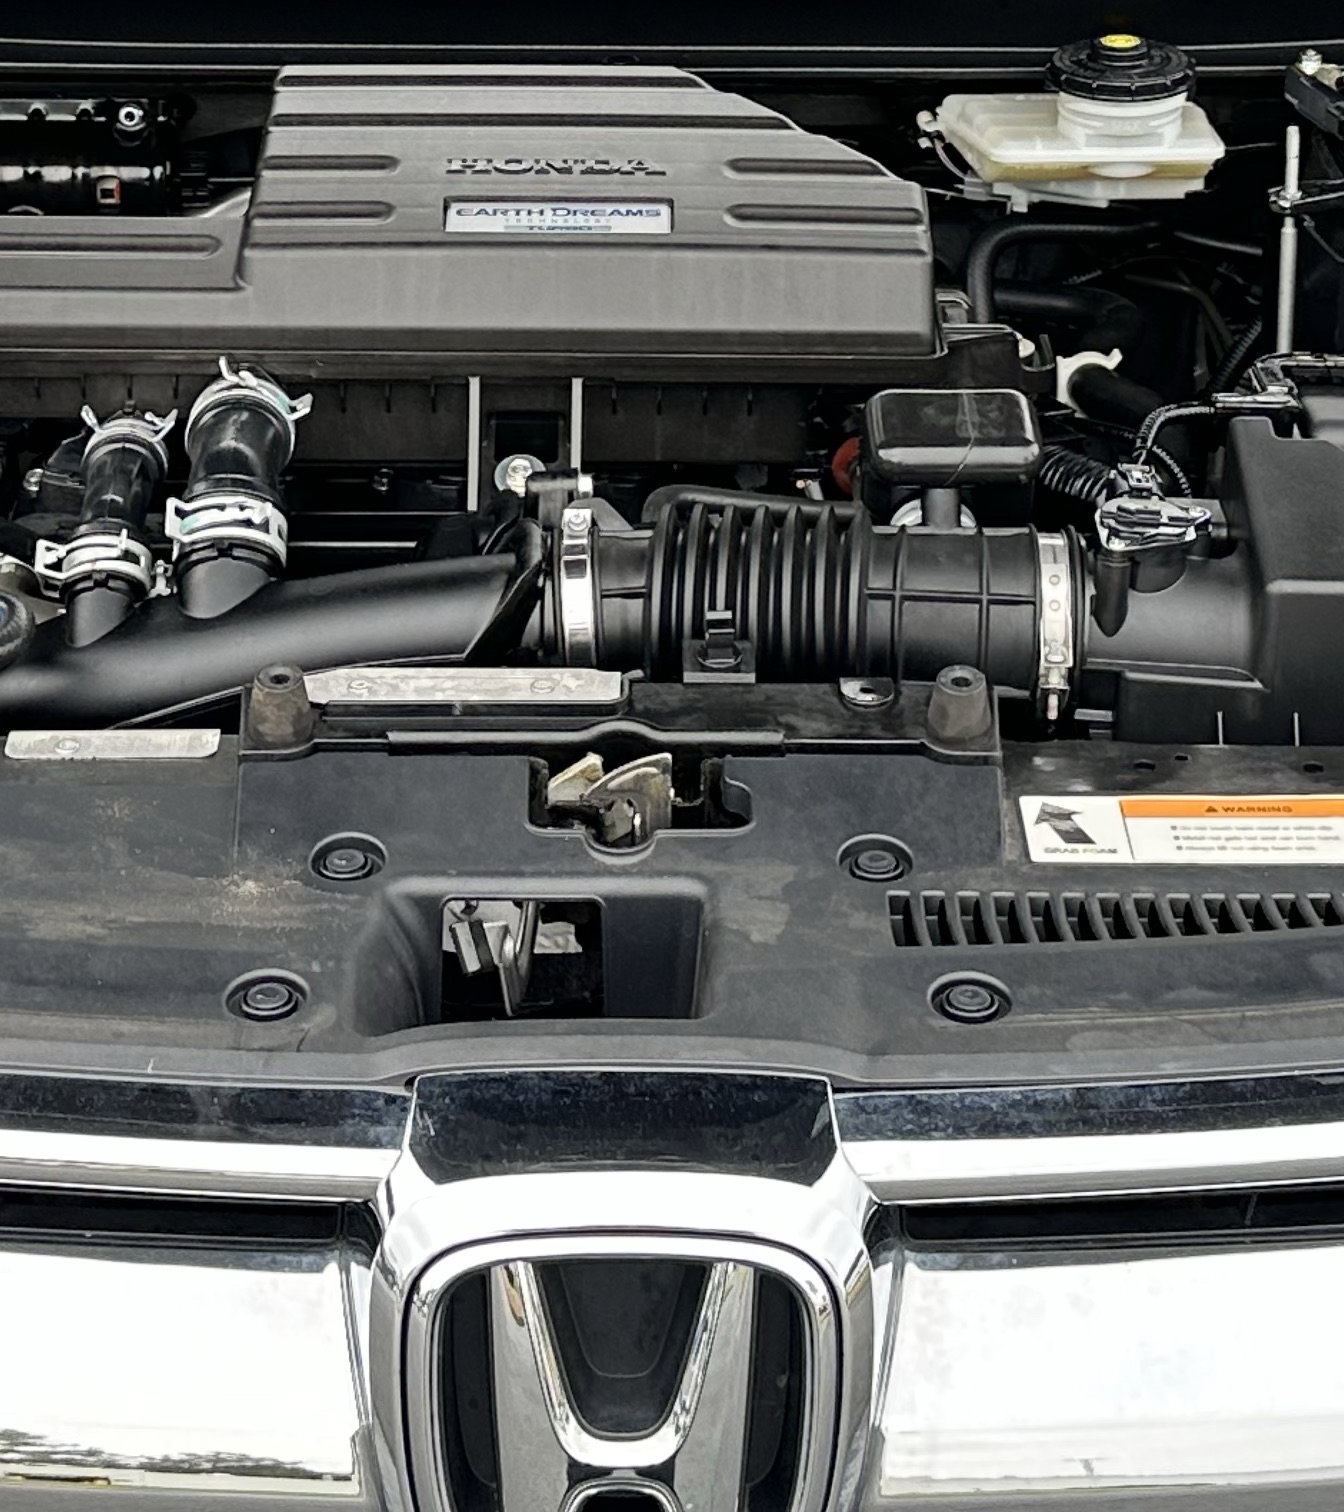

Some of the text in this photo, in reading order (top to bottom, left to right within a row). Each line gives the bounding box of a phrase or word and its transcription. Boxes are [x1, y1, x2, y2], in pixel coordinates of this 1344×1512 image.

[445, 157, 667, 176] HONDA
[455, 206, 662, 218] EARTH DREAMS
[1221, 806, 1294, 814] WARNING
